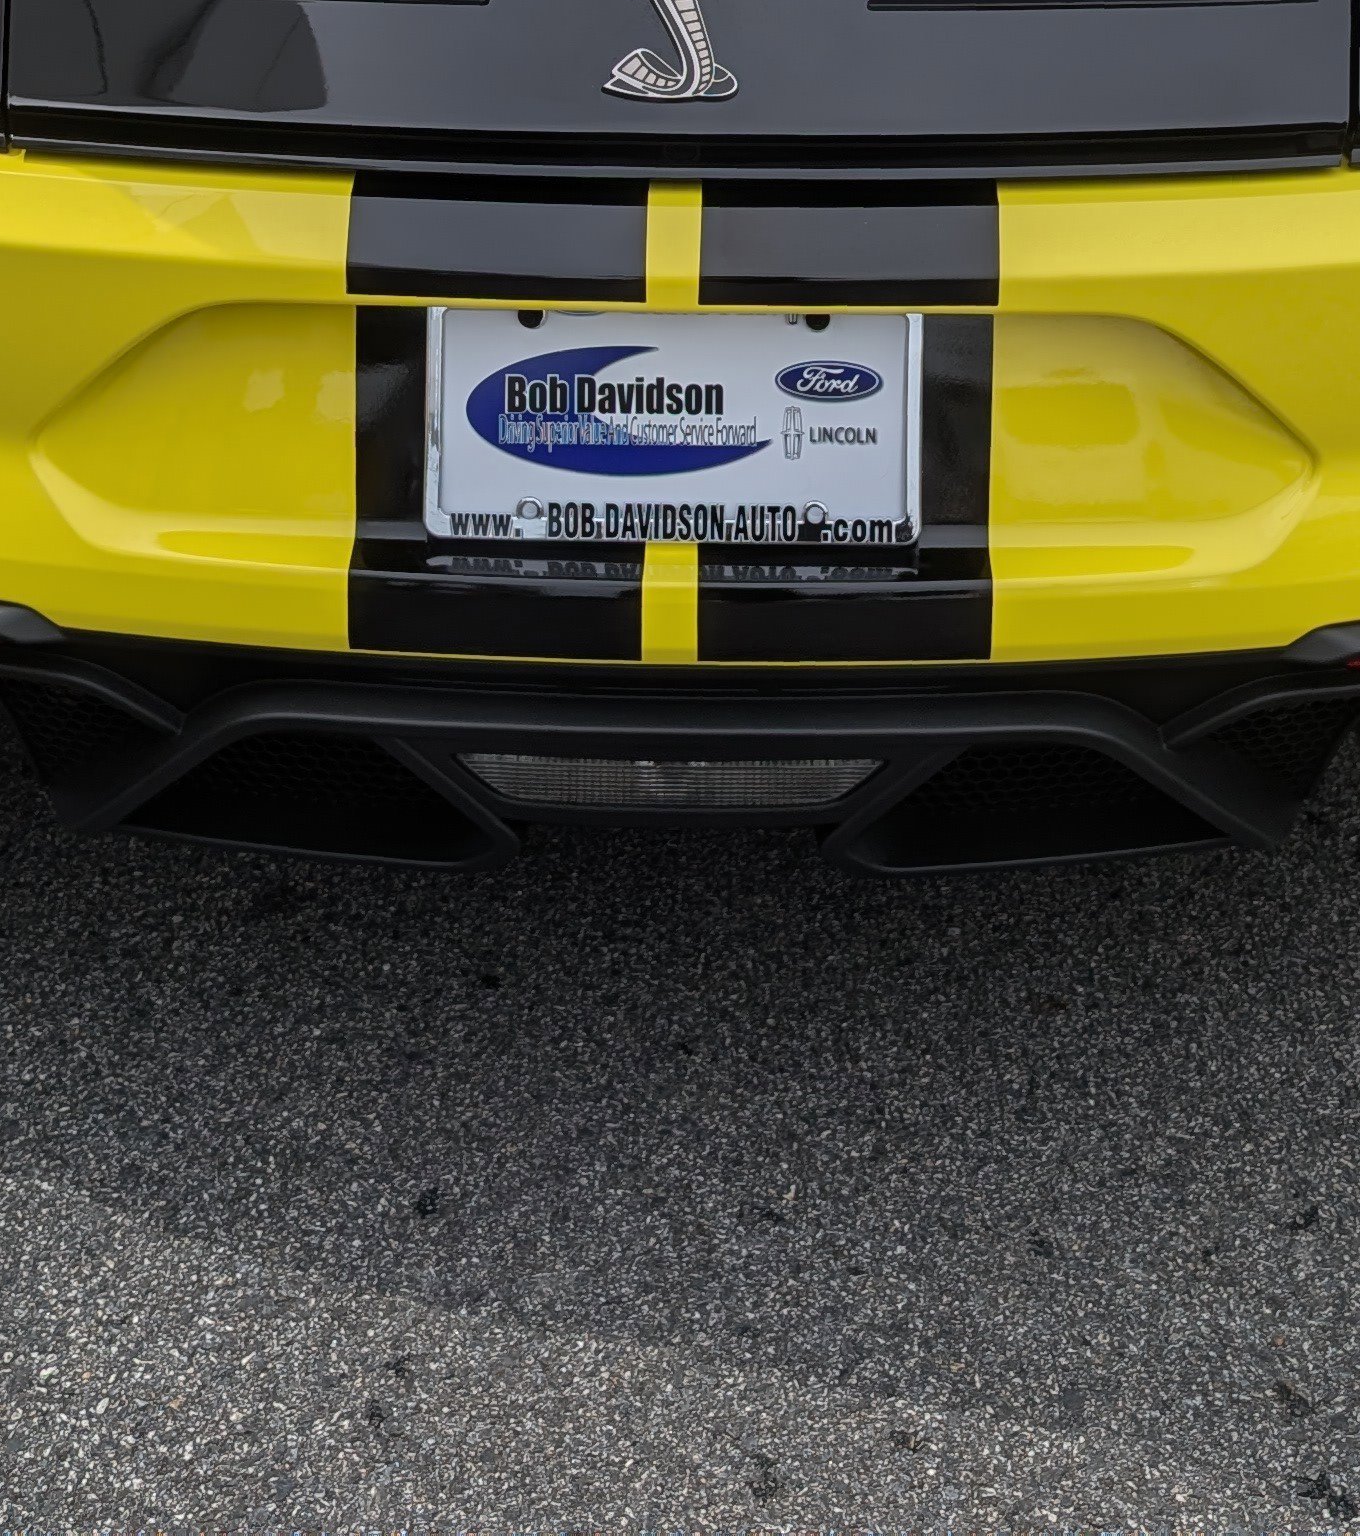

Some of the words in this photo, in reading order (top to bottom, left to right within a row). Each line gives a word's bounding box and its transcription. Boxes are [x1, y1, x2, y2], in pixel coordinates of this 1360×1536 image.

[506, 375, 568, 414] Bob
[576, 375, 724, 415] Davidson
[796, 366, 859, 394] Ford
[498, 414, 536, 453] Driving
[536, 413, 578, 453] Superior
[578, 414, 607, 445] Value
[607, 415, 628, 445] And
[628, 416, 677, 445] Customer
[680, 416, 714, 445] Service
[716, 415, 757, 446] Forward
[809, 426, 877, 444] LINCOLN
[547, 501, 596, 539] BOB
[605, 501, 725, 541] DAVIDSON
[733, 504, 797, 543] AUTO
[819, 517, 893, 544] .com
